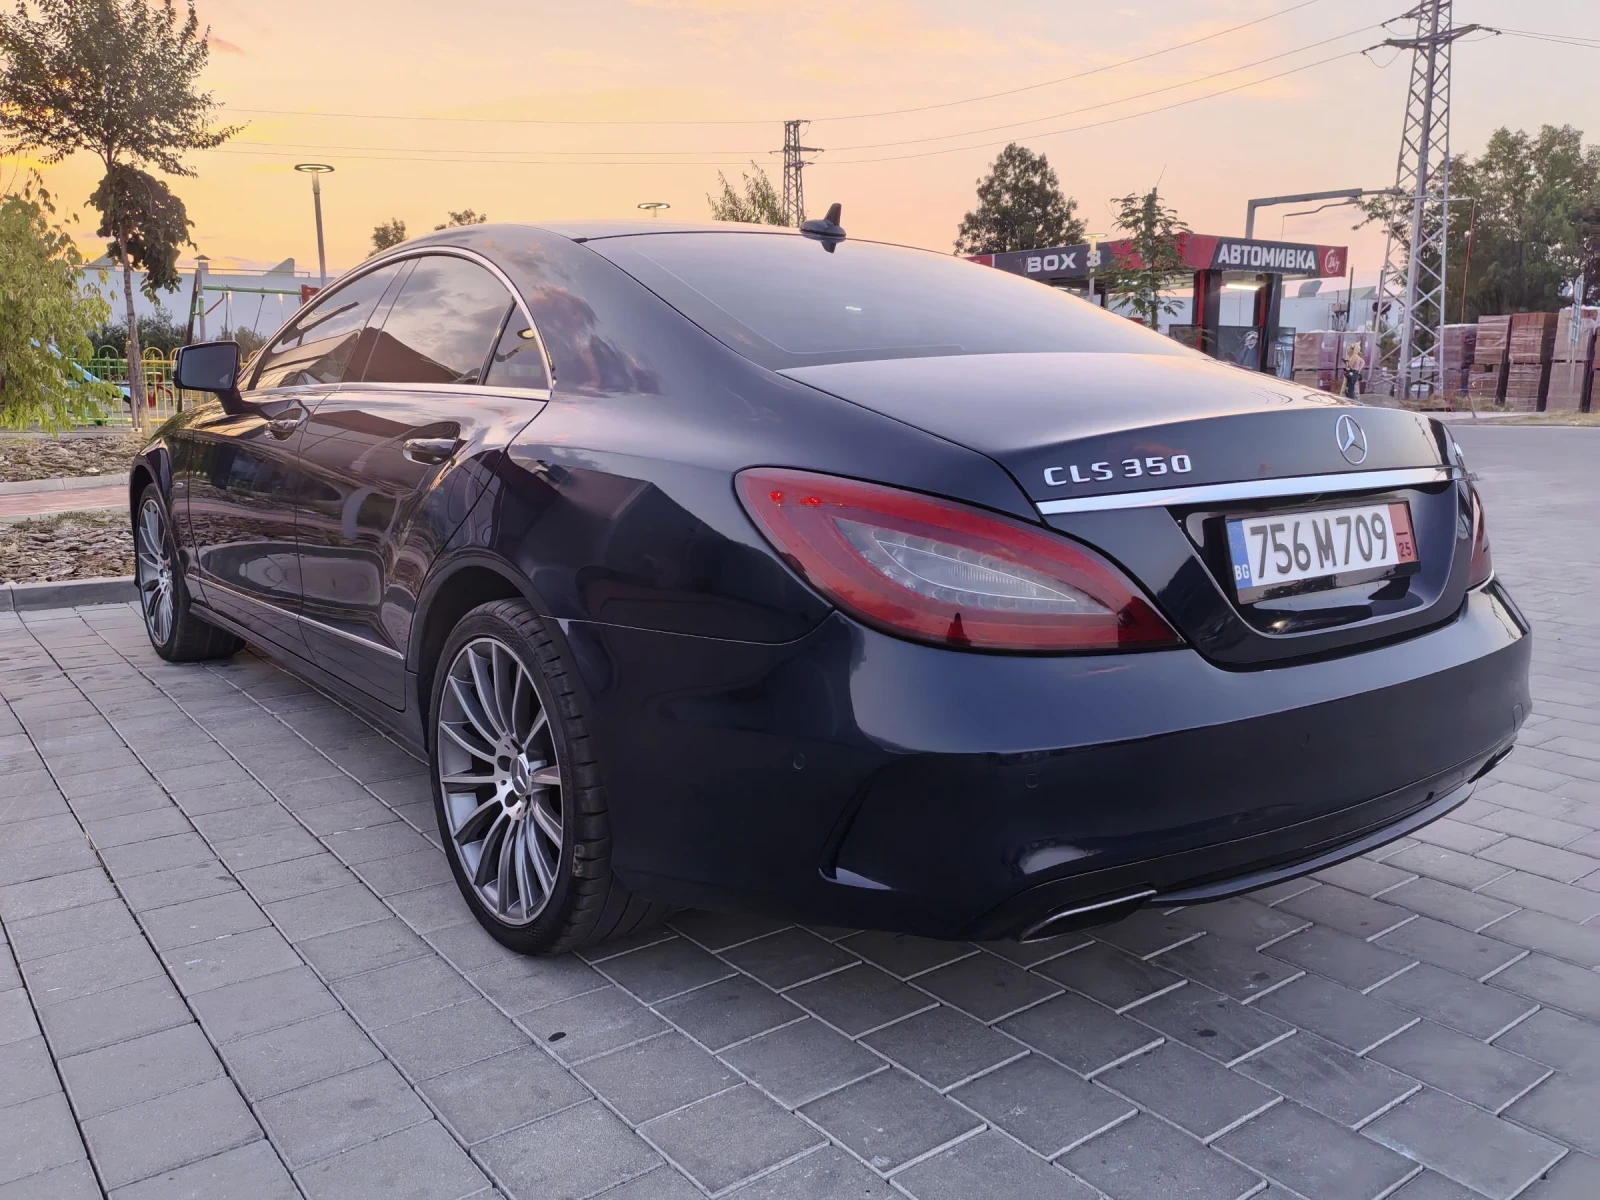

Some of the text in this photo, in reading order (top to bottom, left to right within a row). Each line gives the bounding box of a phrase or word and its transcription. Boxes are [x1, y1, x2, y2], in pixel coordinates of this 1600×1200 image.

[1027, 252, 1076, 273] BOX
[1217, 243, 1316, 270] АВТОМИВКА
[1043, 454, 1192, 487] CLS 350
[1398, 541, 1412, 558] 25
[1234, 563, 1250, 581] BG
